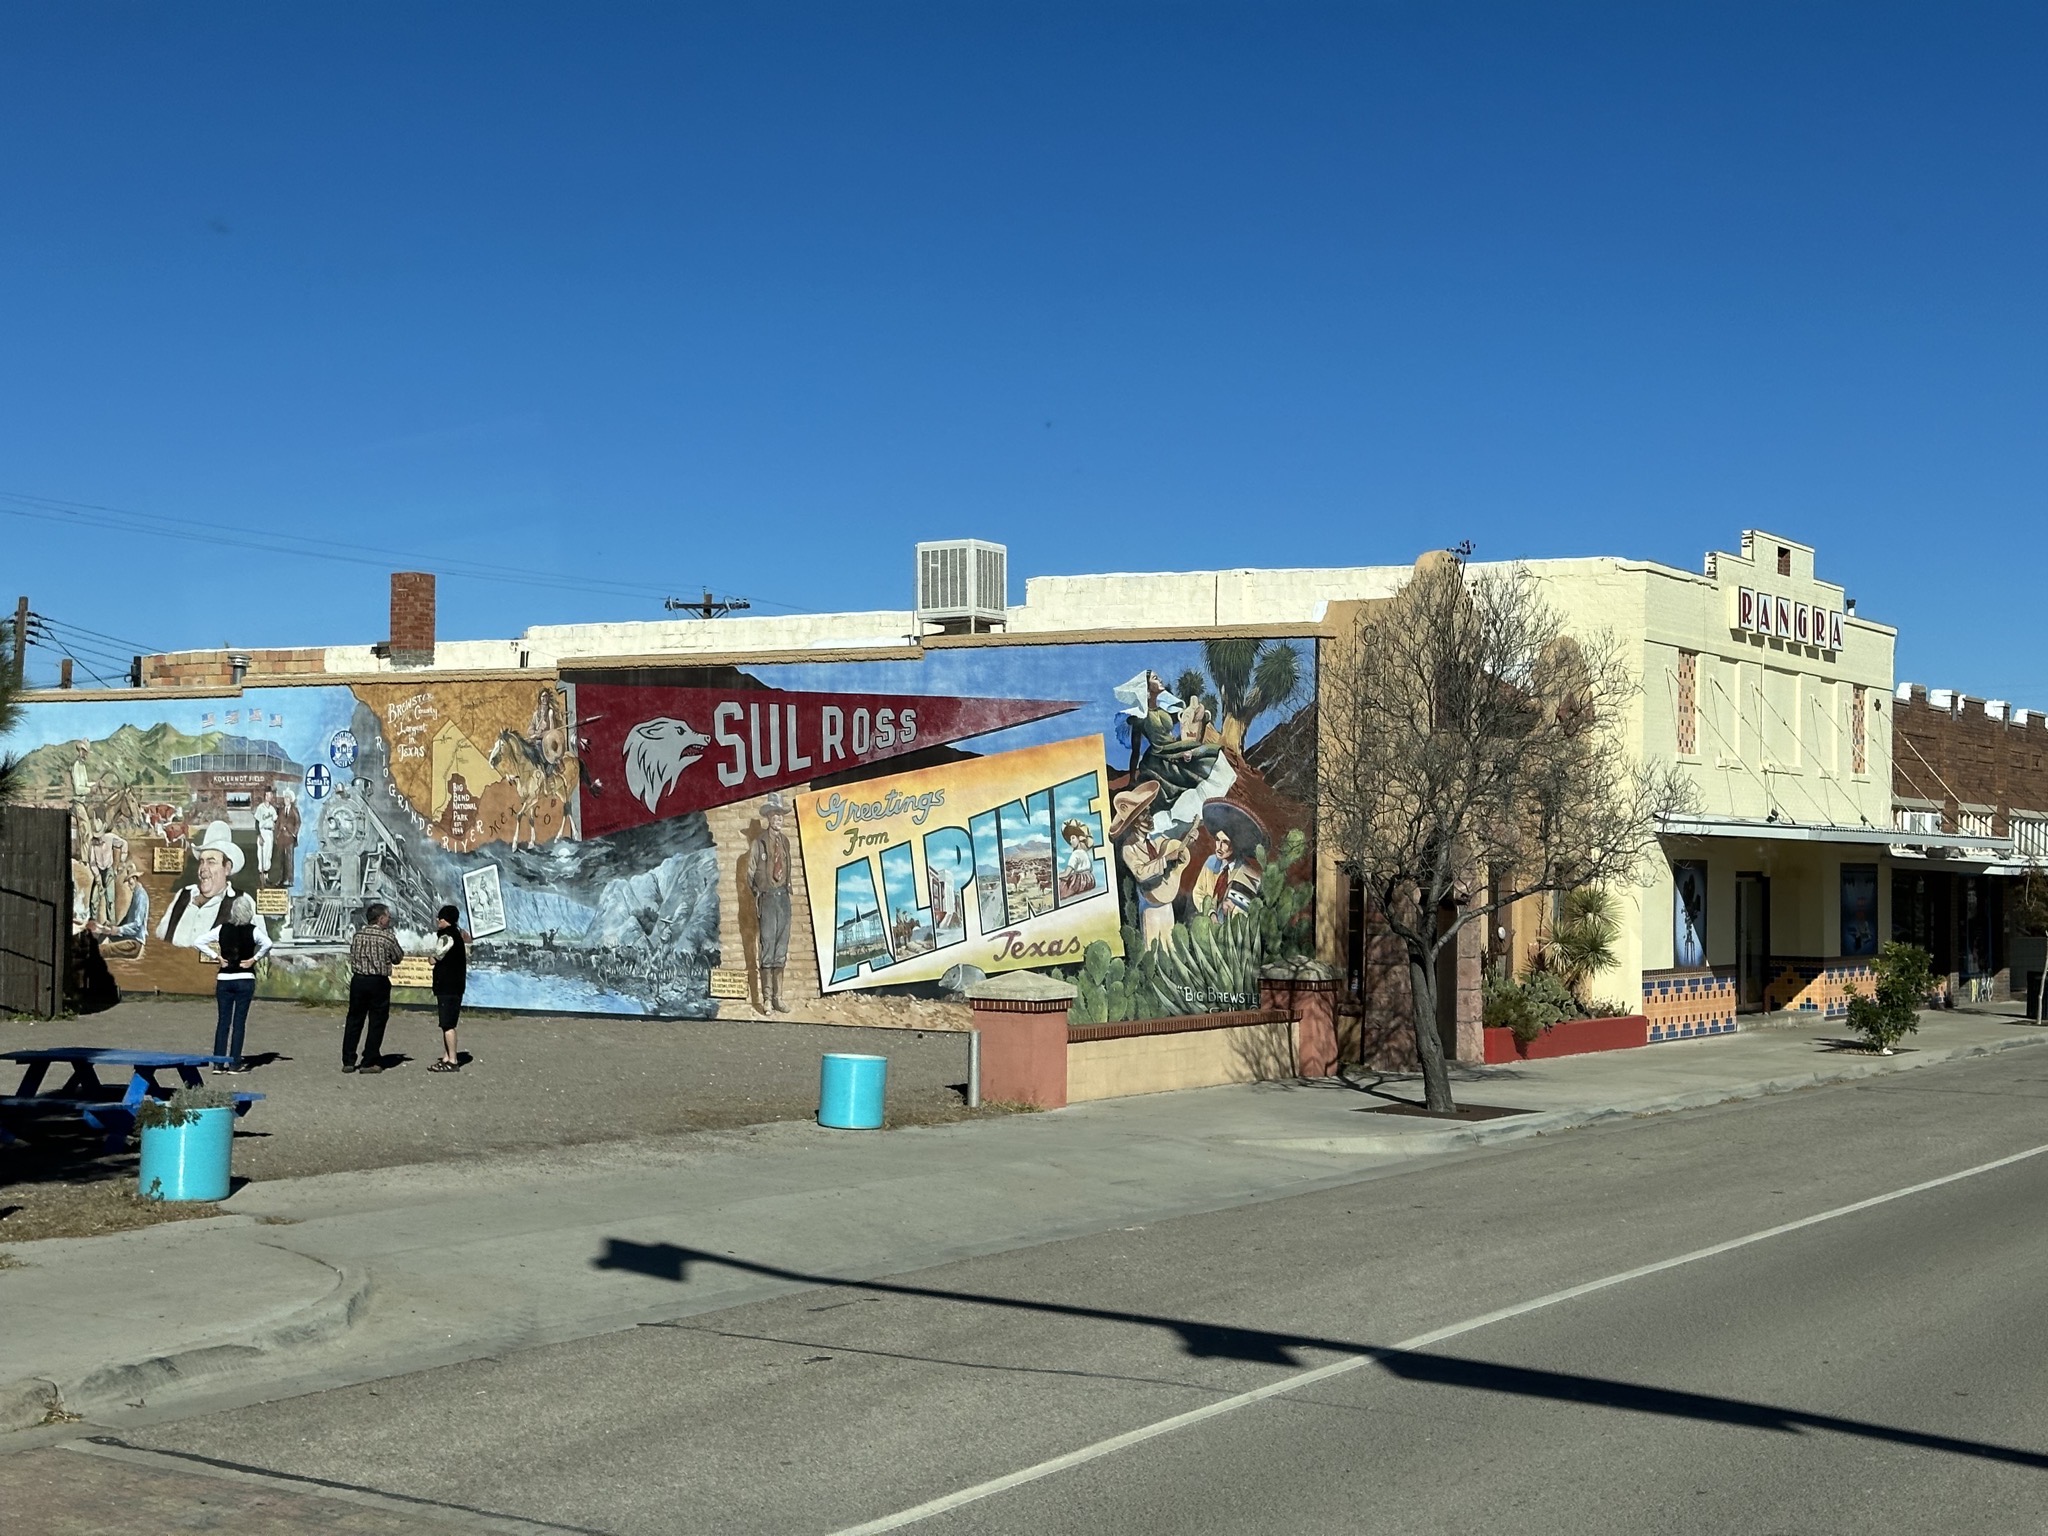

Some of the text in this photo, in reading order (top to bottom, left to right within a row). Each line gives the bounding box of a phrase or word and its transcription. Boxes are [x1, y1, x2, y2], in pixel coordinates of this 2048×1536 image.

[1742, 592, 1842, 647] RANGRA
[387, 692, 434, 724] BREWSTER
[414, 705, 438, 720] County
[409, 735, 416, 744] in
[713, 701, 917, 788] SUL ROSS
[306, 777, 322, 786] Santa
[375, 736, 484, 853] RIO GRANDE RIVER
[816, 788, 946, 831] Greetings
[842, 828, 889, 856] From
[828, 769, 1109, 986] ALPINE
[987, 930, 1081, 962] Texas
